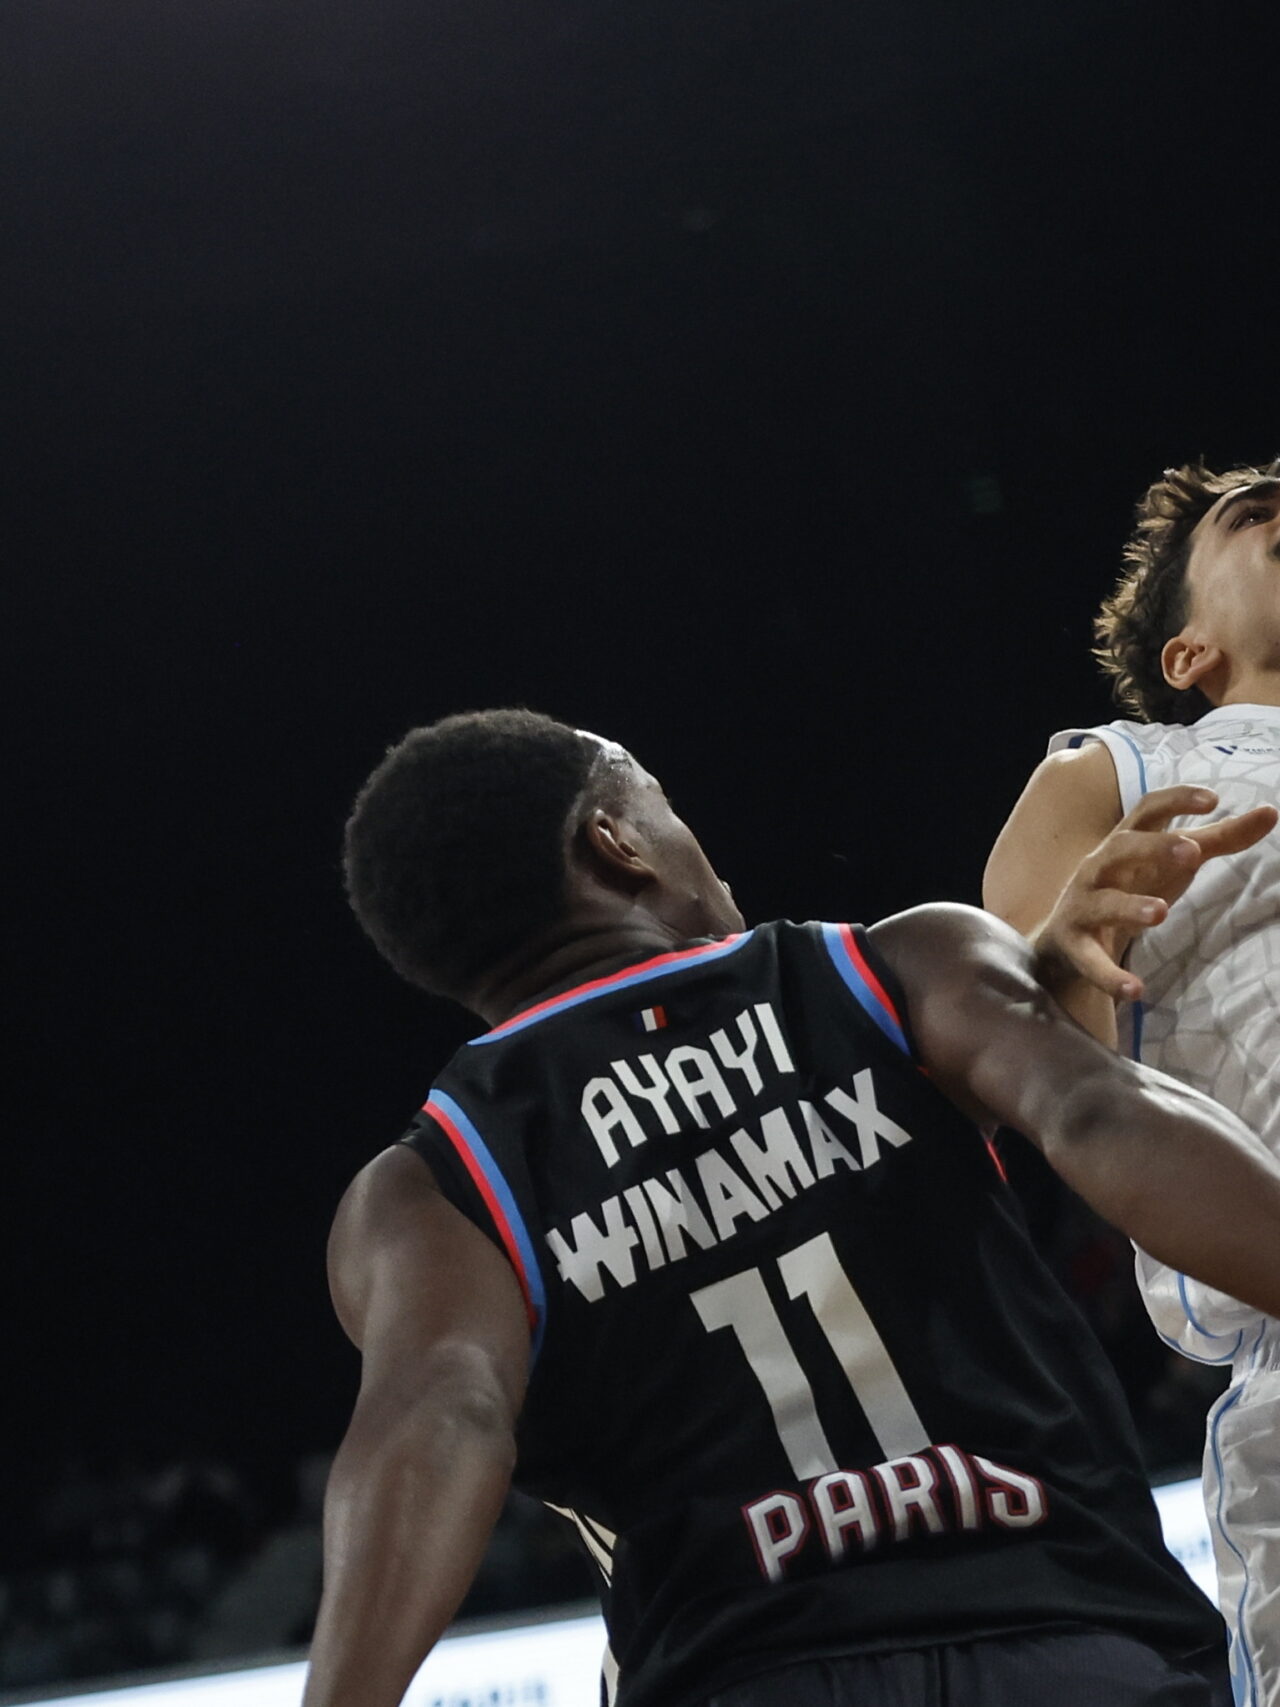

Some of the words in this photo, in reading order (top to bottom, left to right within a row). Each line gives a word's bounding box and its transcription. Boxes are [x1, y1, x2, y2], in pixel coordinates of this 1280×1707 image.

[545, 1067, 914, 1303] WINAMAX
[581, 1002, 796, 1169] AYAYI
[689, 1231, 934, 1482] 11
[741, 1443, 1049, 1585] PARIS
